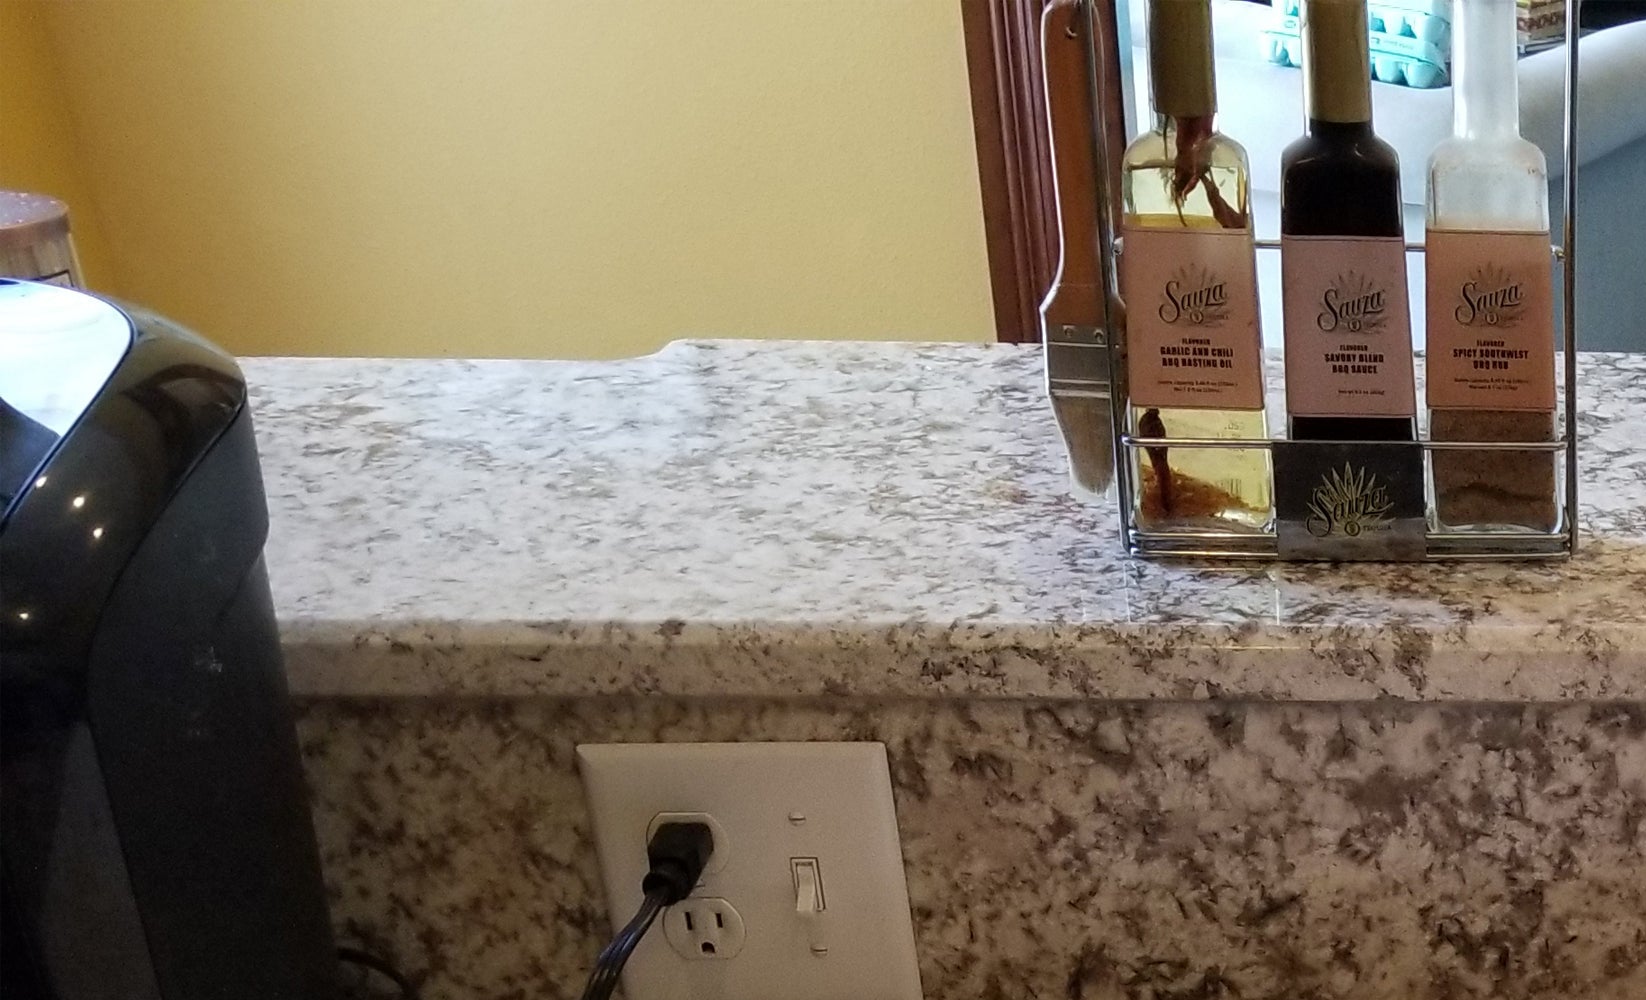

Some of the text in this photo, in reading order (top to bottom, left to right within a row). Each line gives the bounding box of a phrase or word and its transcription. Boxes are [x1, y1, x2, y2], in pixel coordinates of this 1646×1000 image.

[1159, 280, 1227, 324] Sauza
[1455, 281, 1523, 326] Sauza
[1317, 288, 1385, 332] Sauza
[1160, 346, 1234, 357] GARLIC AND CHILI
[1453, 349, 1528, 359] SPICY SOUTHWEST
[1325, 353, 1384, 362] SAVORY BLEND
[1162, 358, 1232, 368] BBQ BASTING OIL
[1473, 360, 1508, 369] BBQ RUB
[1332, 365, 1377, 374] BBQ SAUCE
[1306, 486, 1390, 537] Sauza
